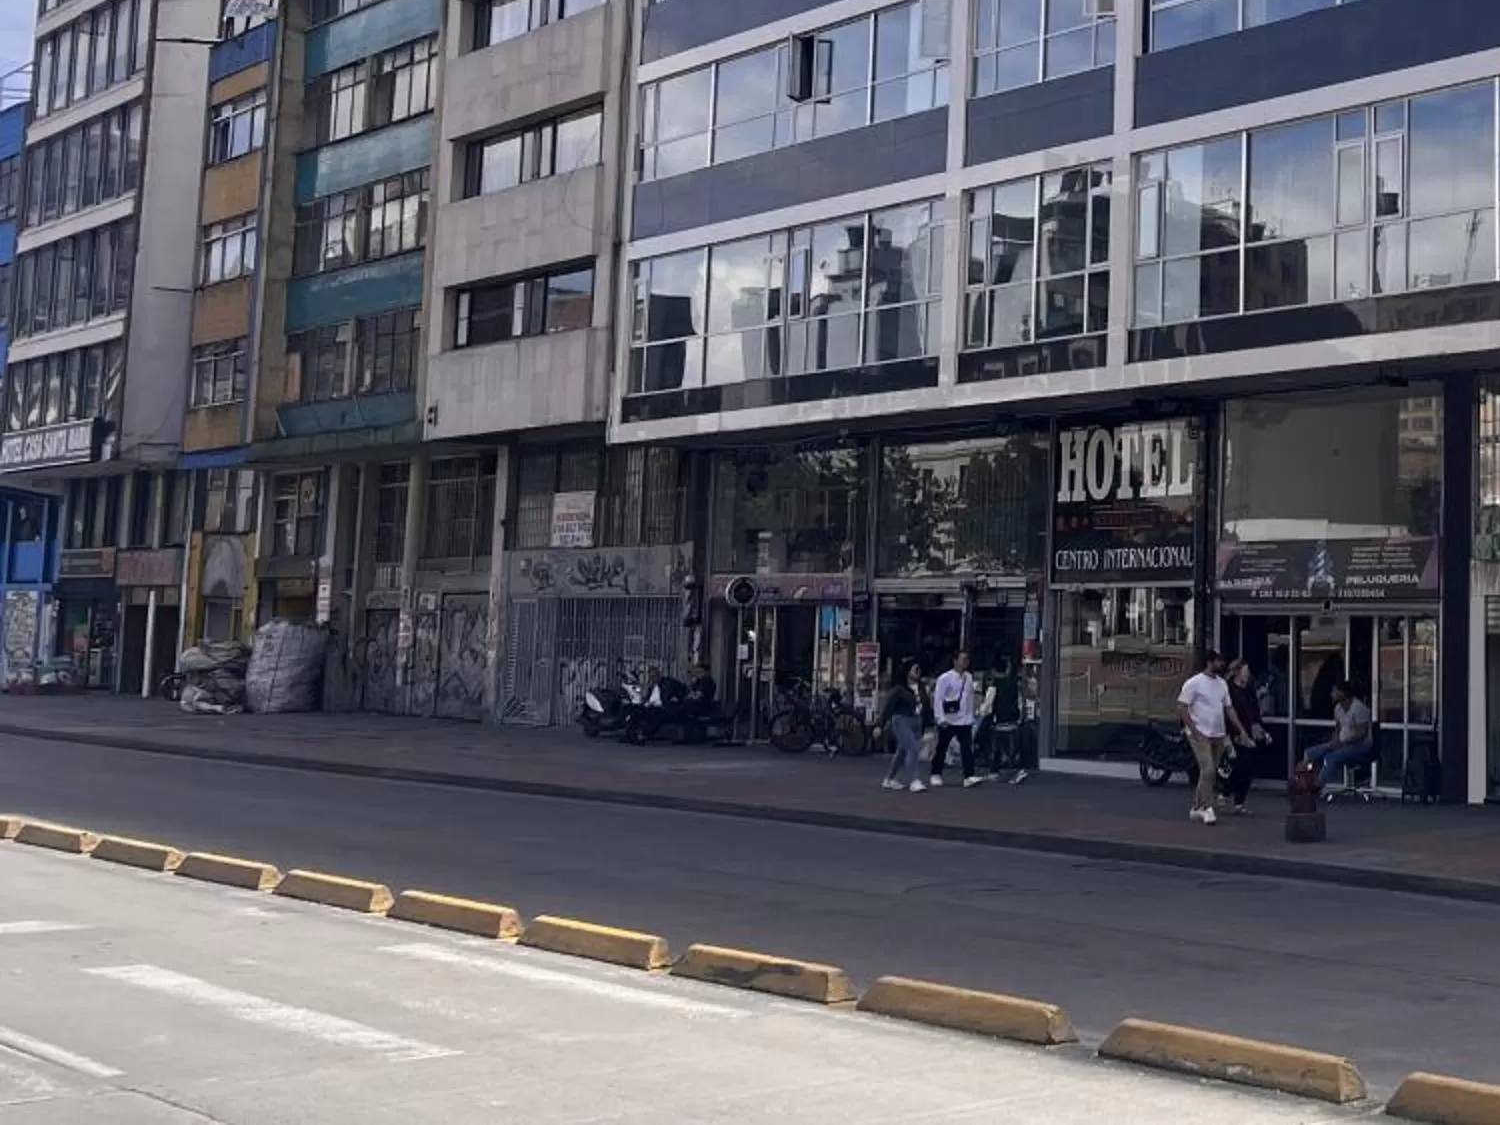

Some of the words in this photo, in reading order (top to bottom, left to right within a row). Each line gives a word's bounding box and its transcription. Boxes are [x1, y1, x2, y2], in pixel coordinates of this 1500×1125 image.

[1057, 422, 1193, 502] HOTEL
[1055, 549, 1099, 570] CENTRO
[1103, 546, 1194, 568] INTERNACIONAL
